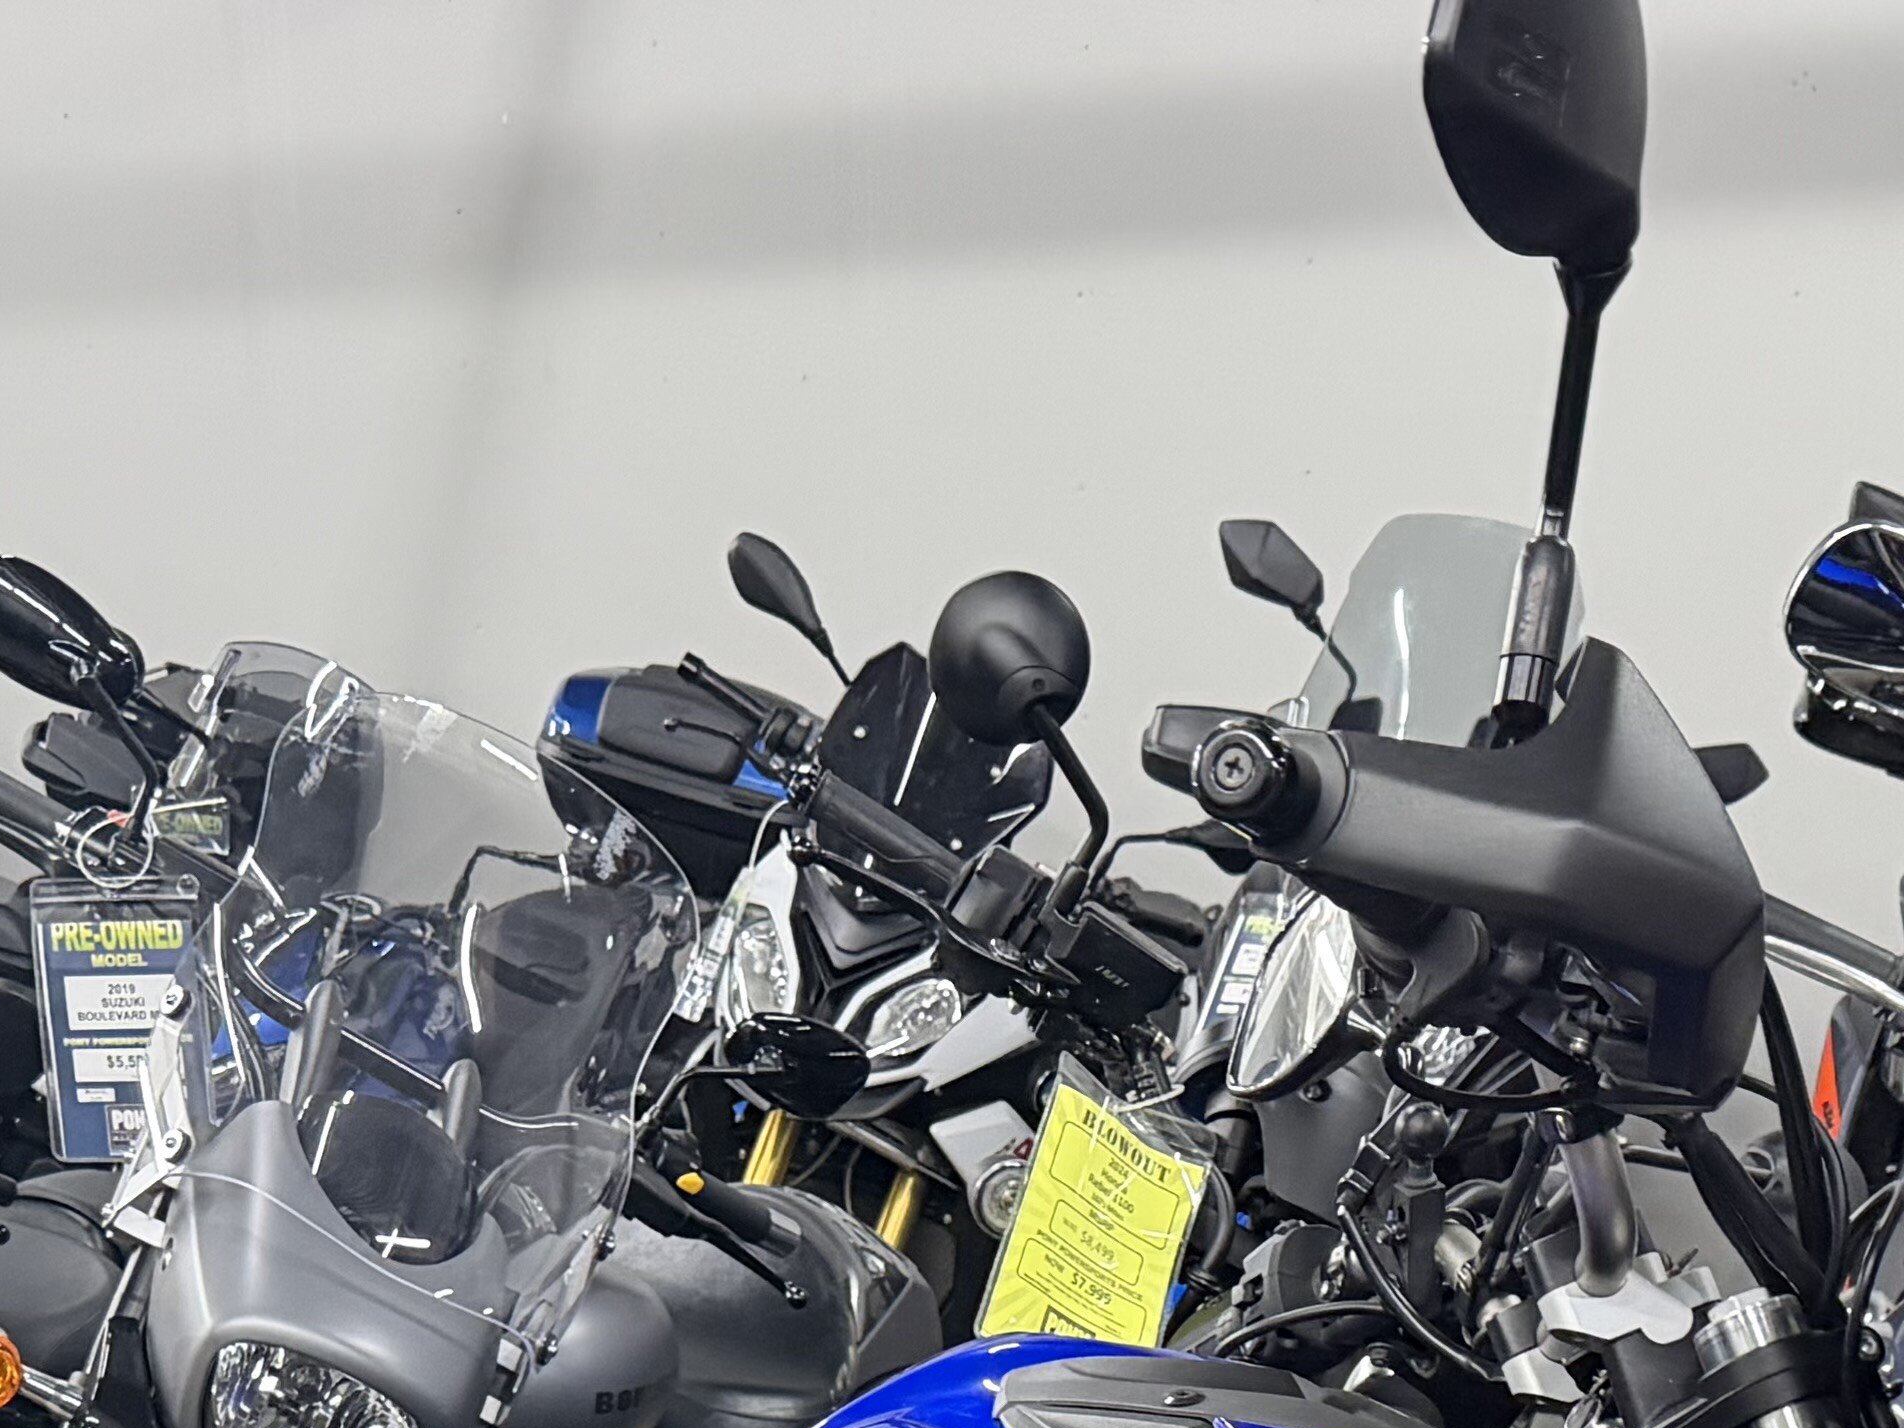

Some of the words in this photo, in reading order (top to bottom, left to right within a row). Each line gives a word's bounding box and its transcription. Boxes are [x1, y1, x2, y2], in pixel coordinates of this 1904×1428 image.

[50, 919, 184, 951] PRE-OWNED
[90, 953, 149, 968] MODEL
[107, 983, 137, 995] 2019
[100, 996, 146, 1009] SUZUKI
[77, 1010, 147, 1022] BOULEVARD
[110, 1109, 147, 1130] PON
[1082, 1109, 1172, 1183] BLOWOUT
